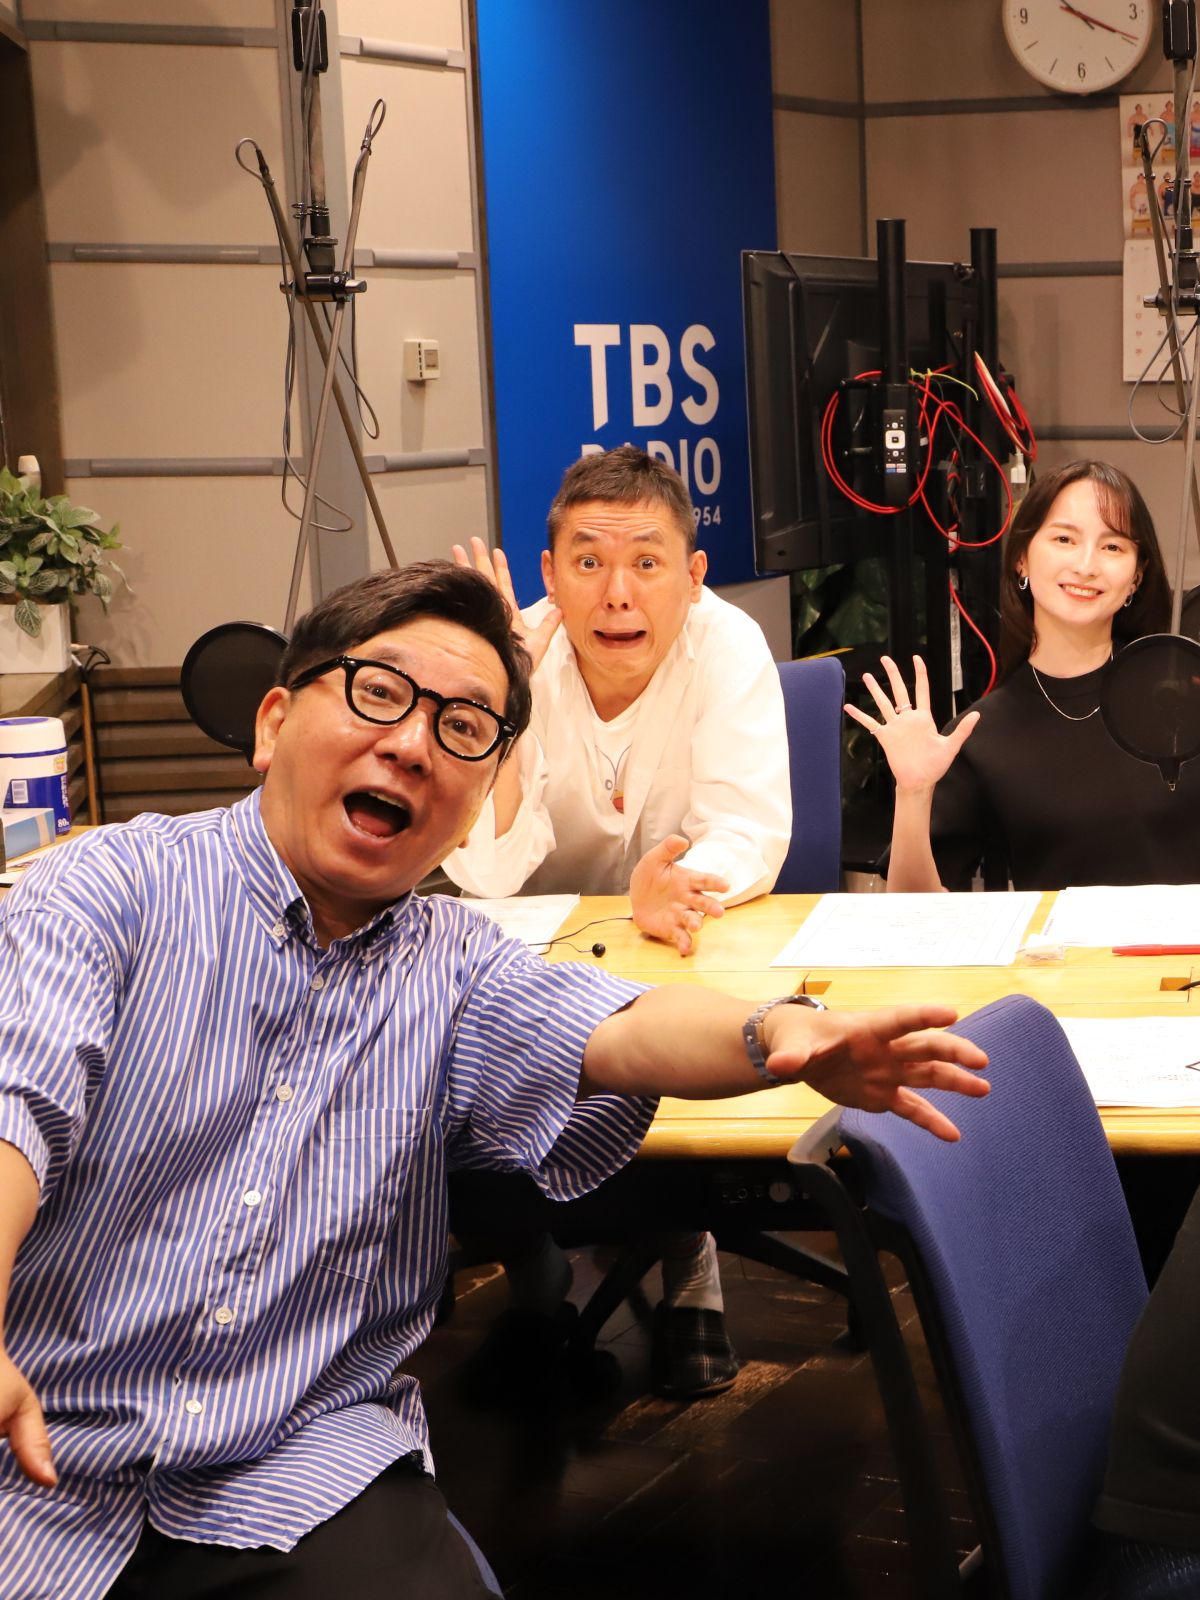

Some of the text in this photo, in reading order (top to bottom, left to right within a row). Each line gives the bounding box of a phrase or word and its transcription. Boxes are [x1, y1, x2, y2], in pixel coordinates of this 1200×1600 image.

[1020, 8, 1028, 24] 9
[1128, 3, 1138, 20] 3
[1077, 62, 1086, 79] 6
[573, 323, 720, 432] TBS
[692, 506, 721, 526] 954
